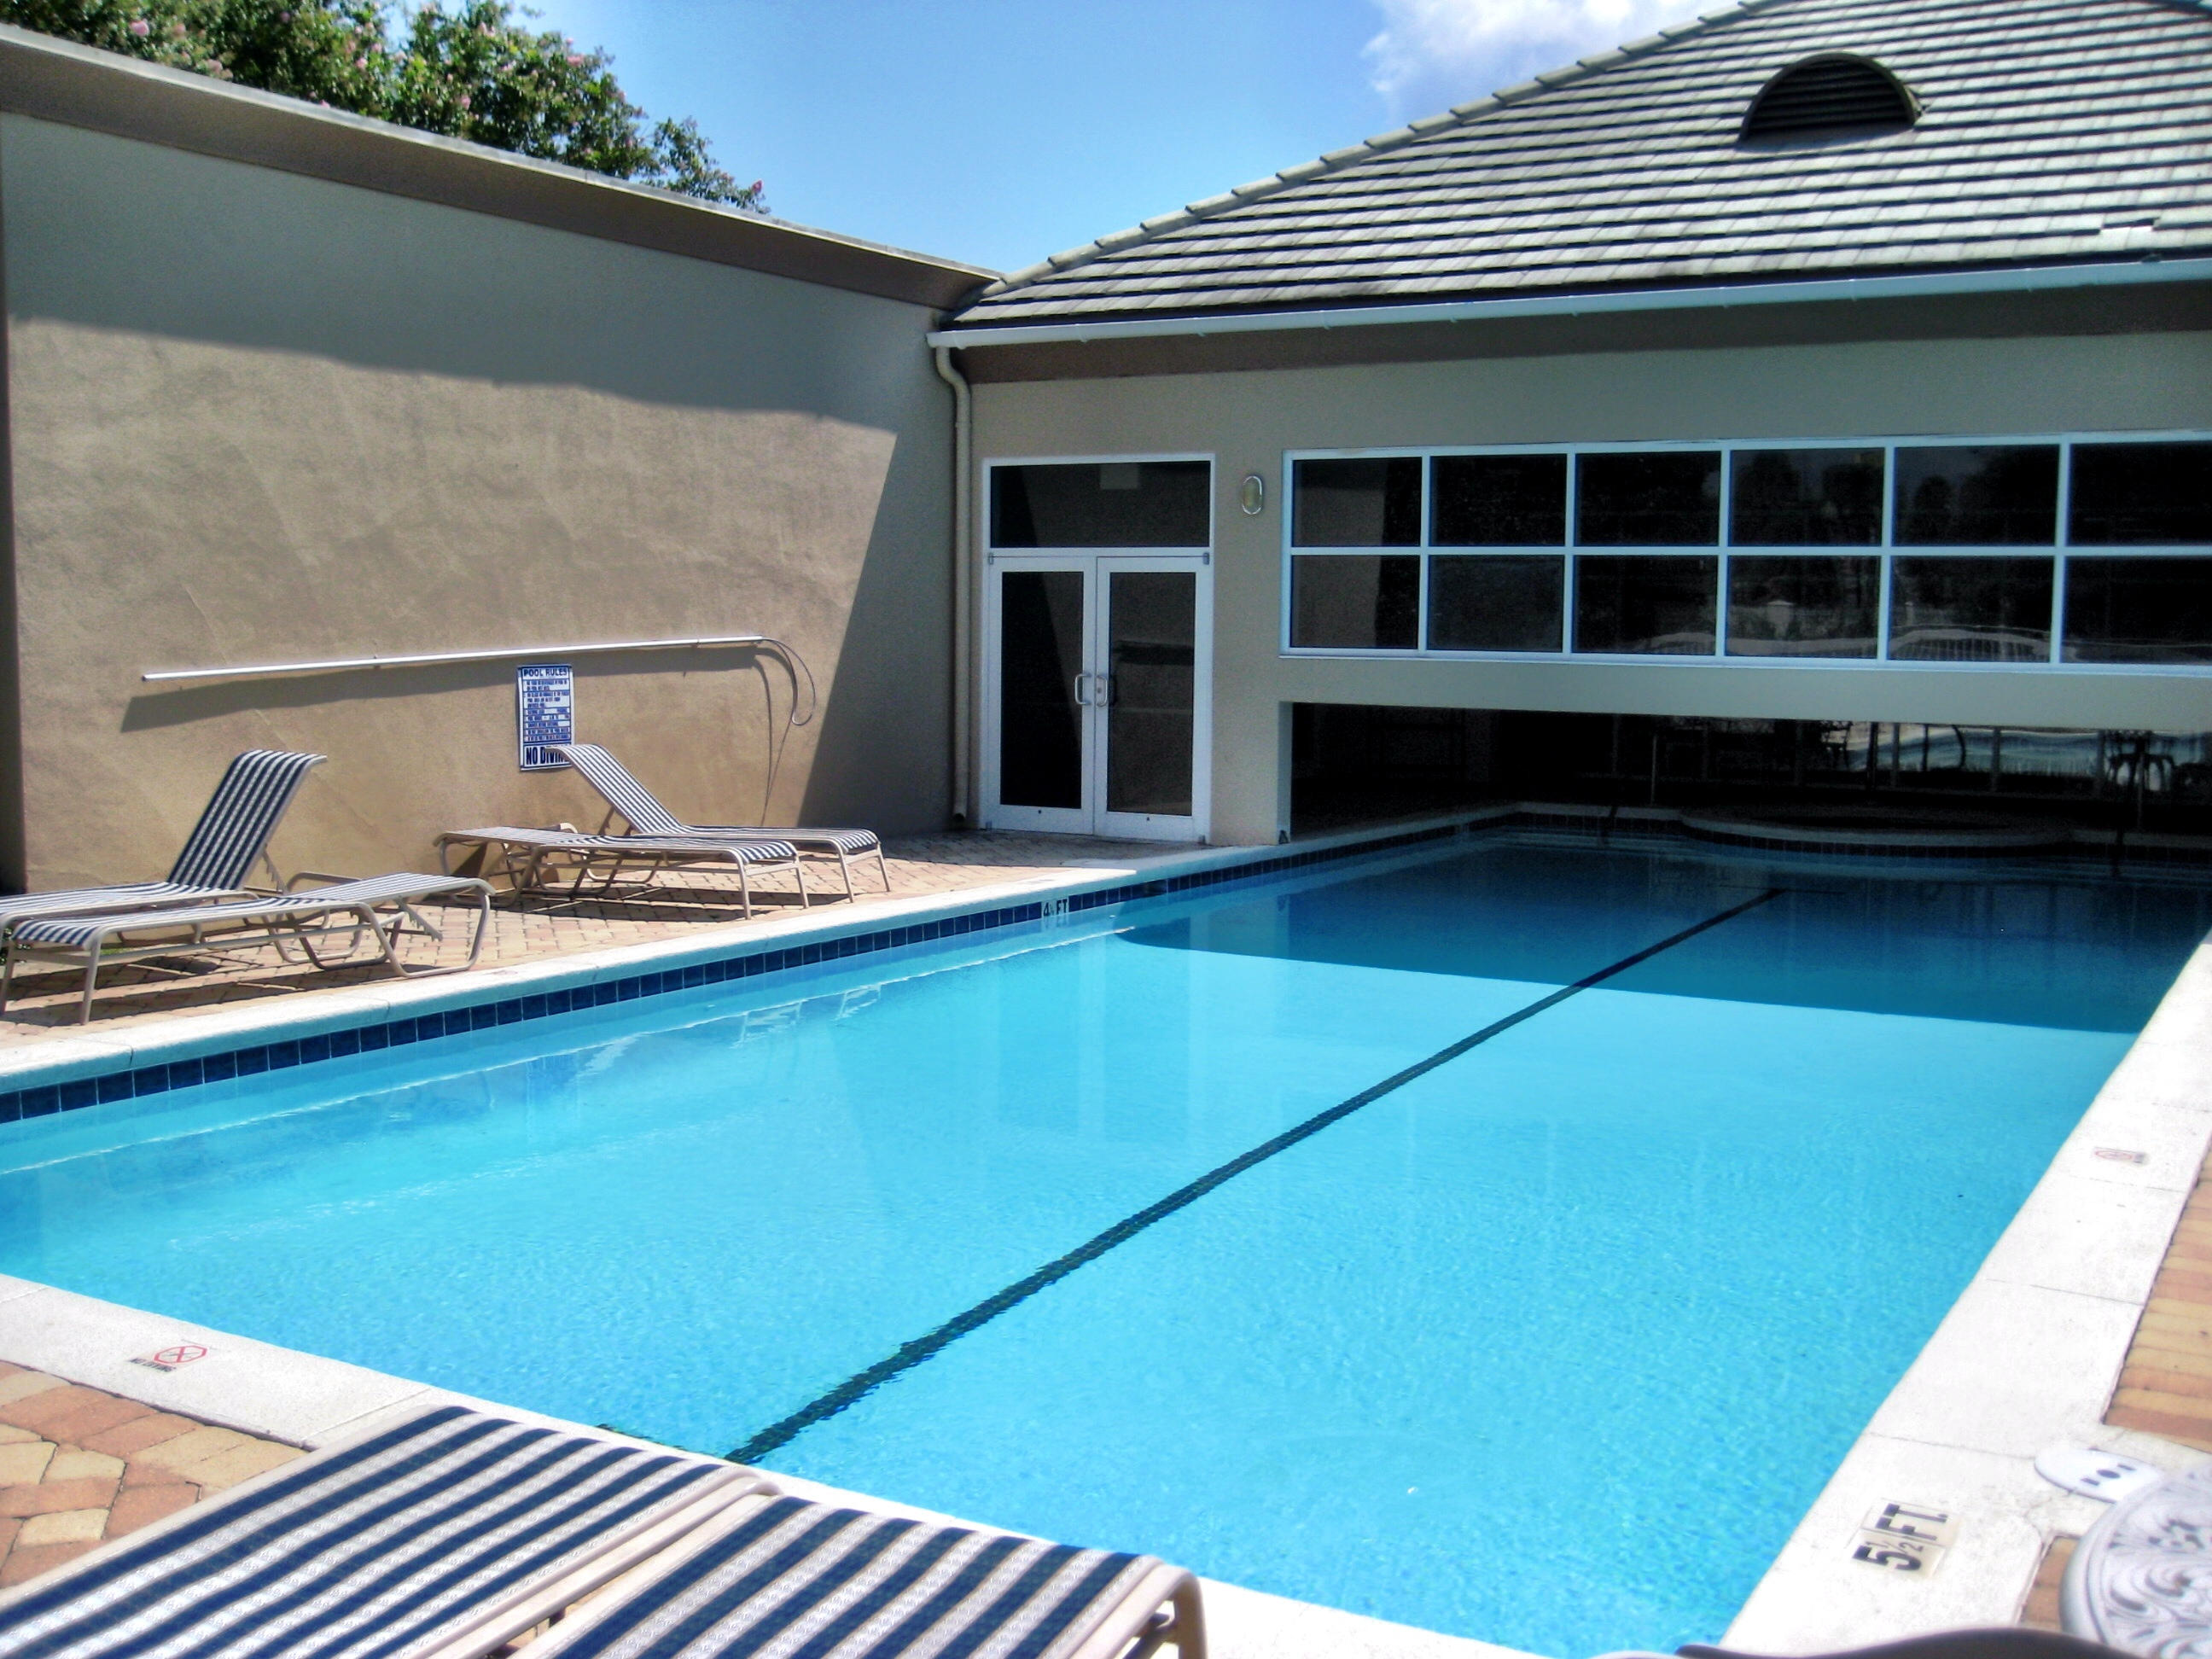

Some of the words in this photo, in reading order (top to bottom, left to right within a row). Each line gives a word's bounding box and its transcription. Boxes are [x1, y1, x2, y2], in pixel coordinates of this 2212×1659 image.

[523, 668, 544, 677] POOL
[526, 747, 538, 765] NO
[539, 746, 570, 764] DIVI
[1056, 899, 1068, 915] FT
